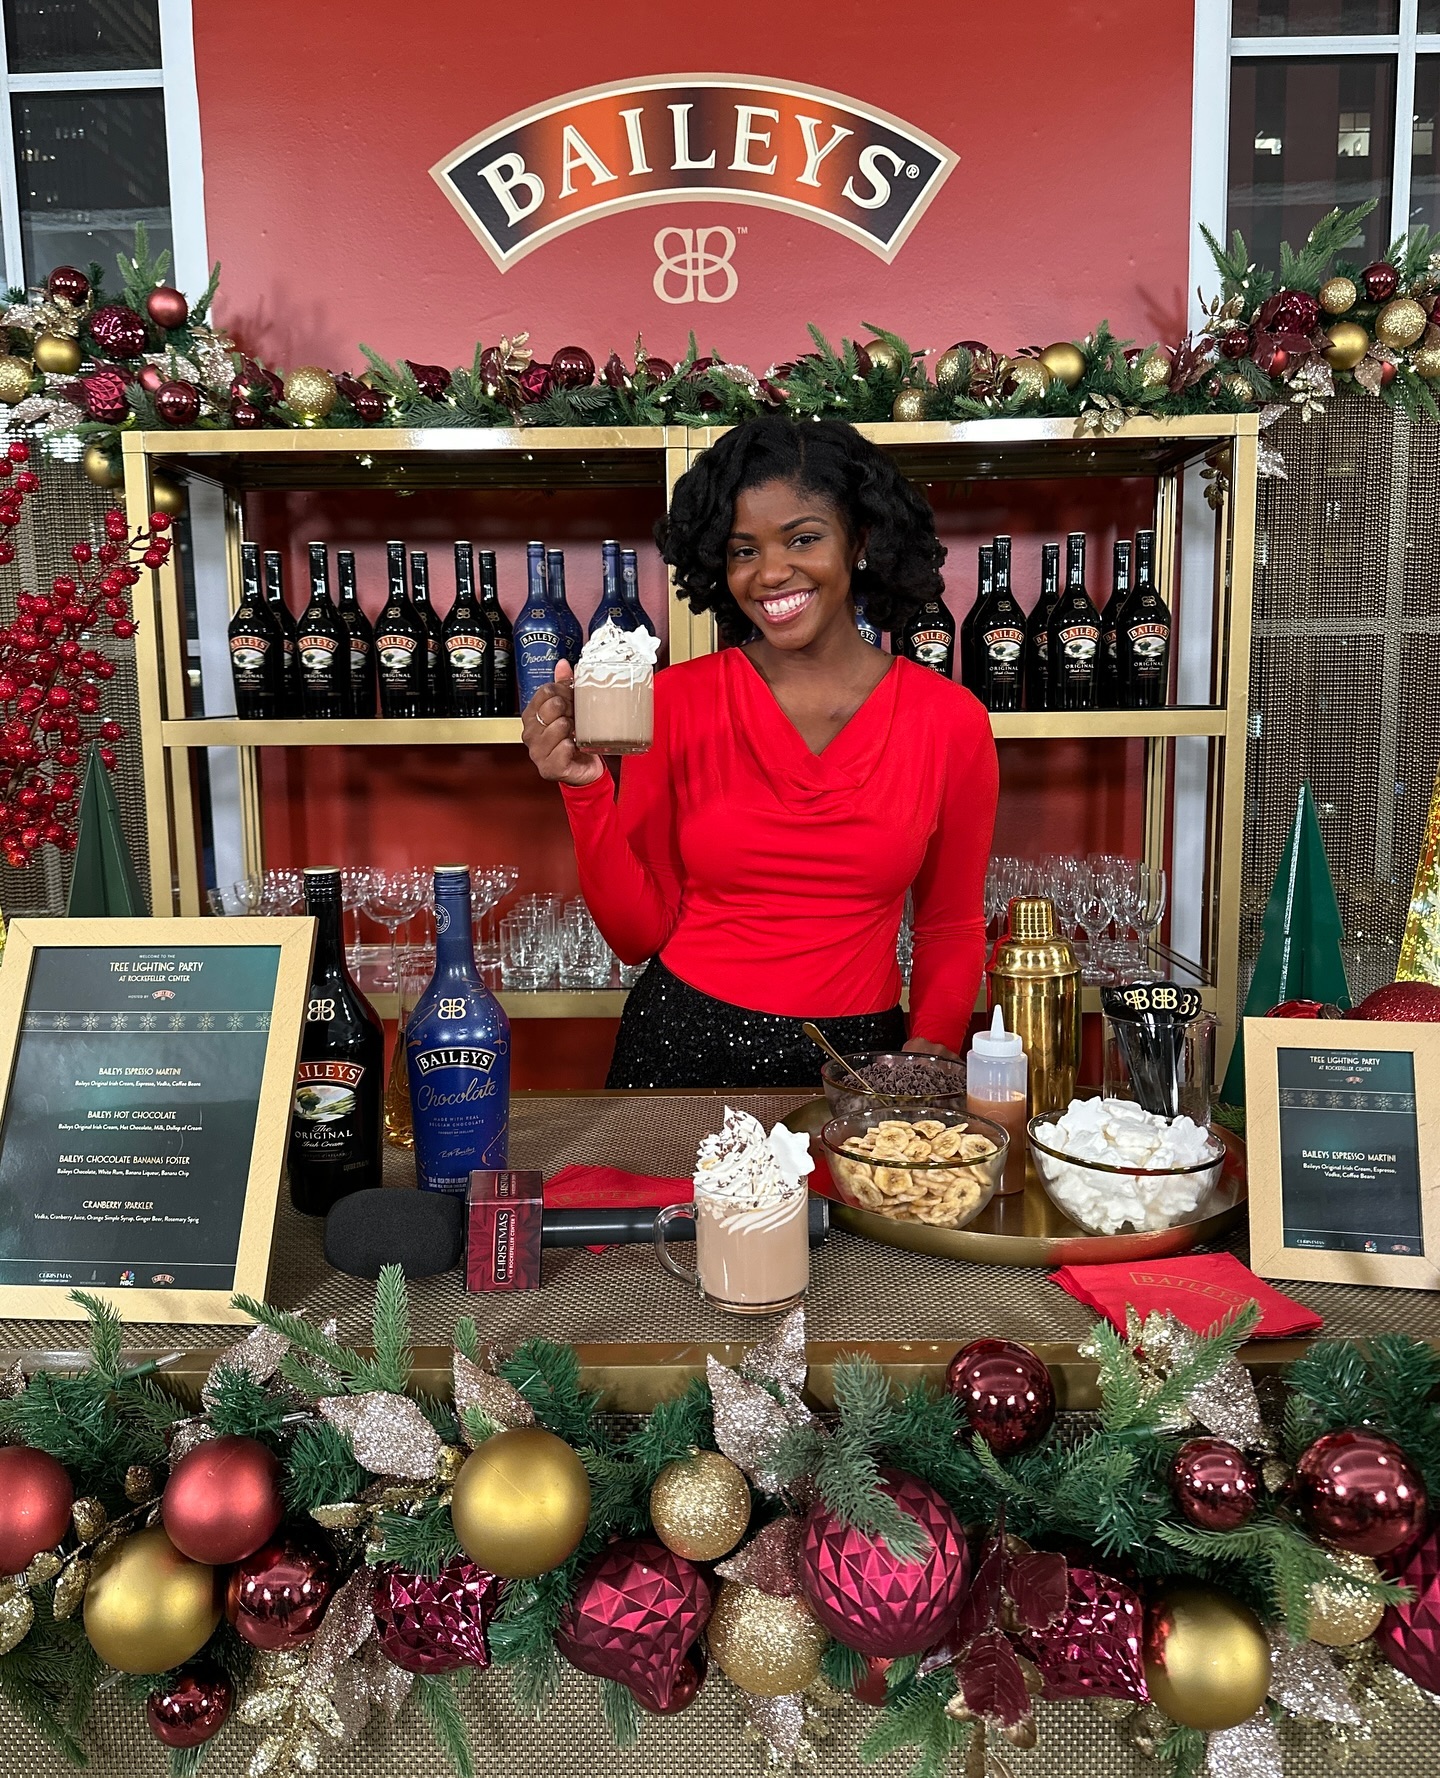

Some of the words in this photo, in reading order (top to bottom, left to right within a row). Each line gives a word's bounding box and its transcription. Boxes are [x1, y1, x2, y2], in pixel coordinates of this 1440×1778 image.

[986, 630, 1022, 642] BAILEYS
[1062, 627, 1099, 640] BAILEYS
[1131, 624, 1168, 637] BAILEYS
[378, 637, 414, 650] BAILEYS
[447, 637, 484, 650] BAILEYS
[523, 633, 557, 644] BAILEYS
[914, 632, 949, 644] BAILEYS
[110, 962, 129, 972] TREE
[132, 962, 175, 972] LIGHTING
[178, 962, 204, 972] PARTY
[420, 1051, 490, 1070] BAILEYS
[1310, 1056, 1325, 1064] TREE
[1327, 1056, 1359, 1065] LIGHTING
[1361, 1057, 1380, 1065] PARTY
[99, 1067, 122, 1076] BAILEYS
[125, 1067, 153, 1076] ESPRESSO
[155, 1067, 182, 1076] MARTINI
[418, 1077, 496, 1111] Chocolate
[88, 1110, 112, 1119] BAILEYS
[114, 1111, 130, 1119] HOT
[132, 1111, 176, 1120] CHOCOLATE
[58, 1123, 73, 1131] Baileys
[312, 1124, 332, 1132] The
[452, 1119, 484, 1127] CHOCOLATE
[295, 1129, 353, 1139] ORIGINAL
[59, 1154, 83, 1163] BAILEYS
[86, 1155, 131, 1164] CHOCOLATE
[133, 1156, 163, 1164] BANANAS
[165, 1156, 190, 1165] FOSTER
[1302, 1150, 1329, 1159] BAILEYS
[1332, 1151, 1365, 1160] ESPRESSO
[1367, 1153, 1396, 1162] MARTINI
[57, 1168, 73, 1176] Baileys
[178, 1170, 189, 1178] Chip
[1321, 1163, 1341, 1171] Original
[1373, 1166, 1397, 1174] Espresso,
[82, 1200, 122, 1209] CRANBERRY
[124, 1201, 153, 1210] SPARKLER
[50, 1213, 73, 1221] Cranberry
[187, 1216, 199, 1224] Sprig
[496, 1213, 509, 1280] CHRISTMAS
